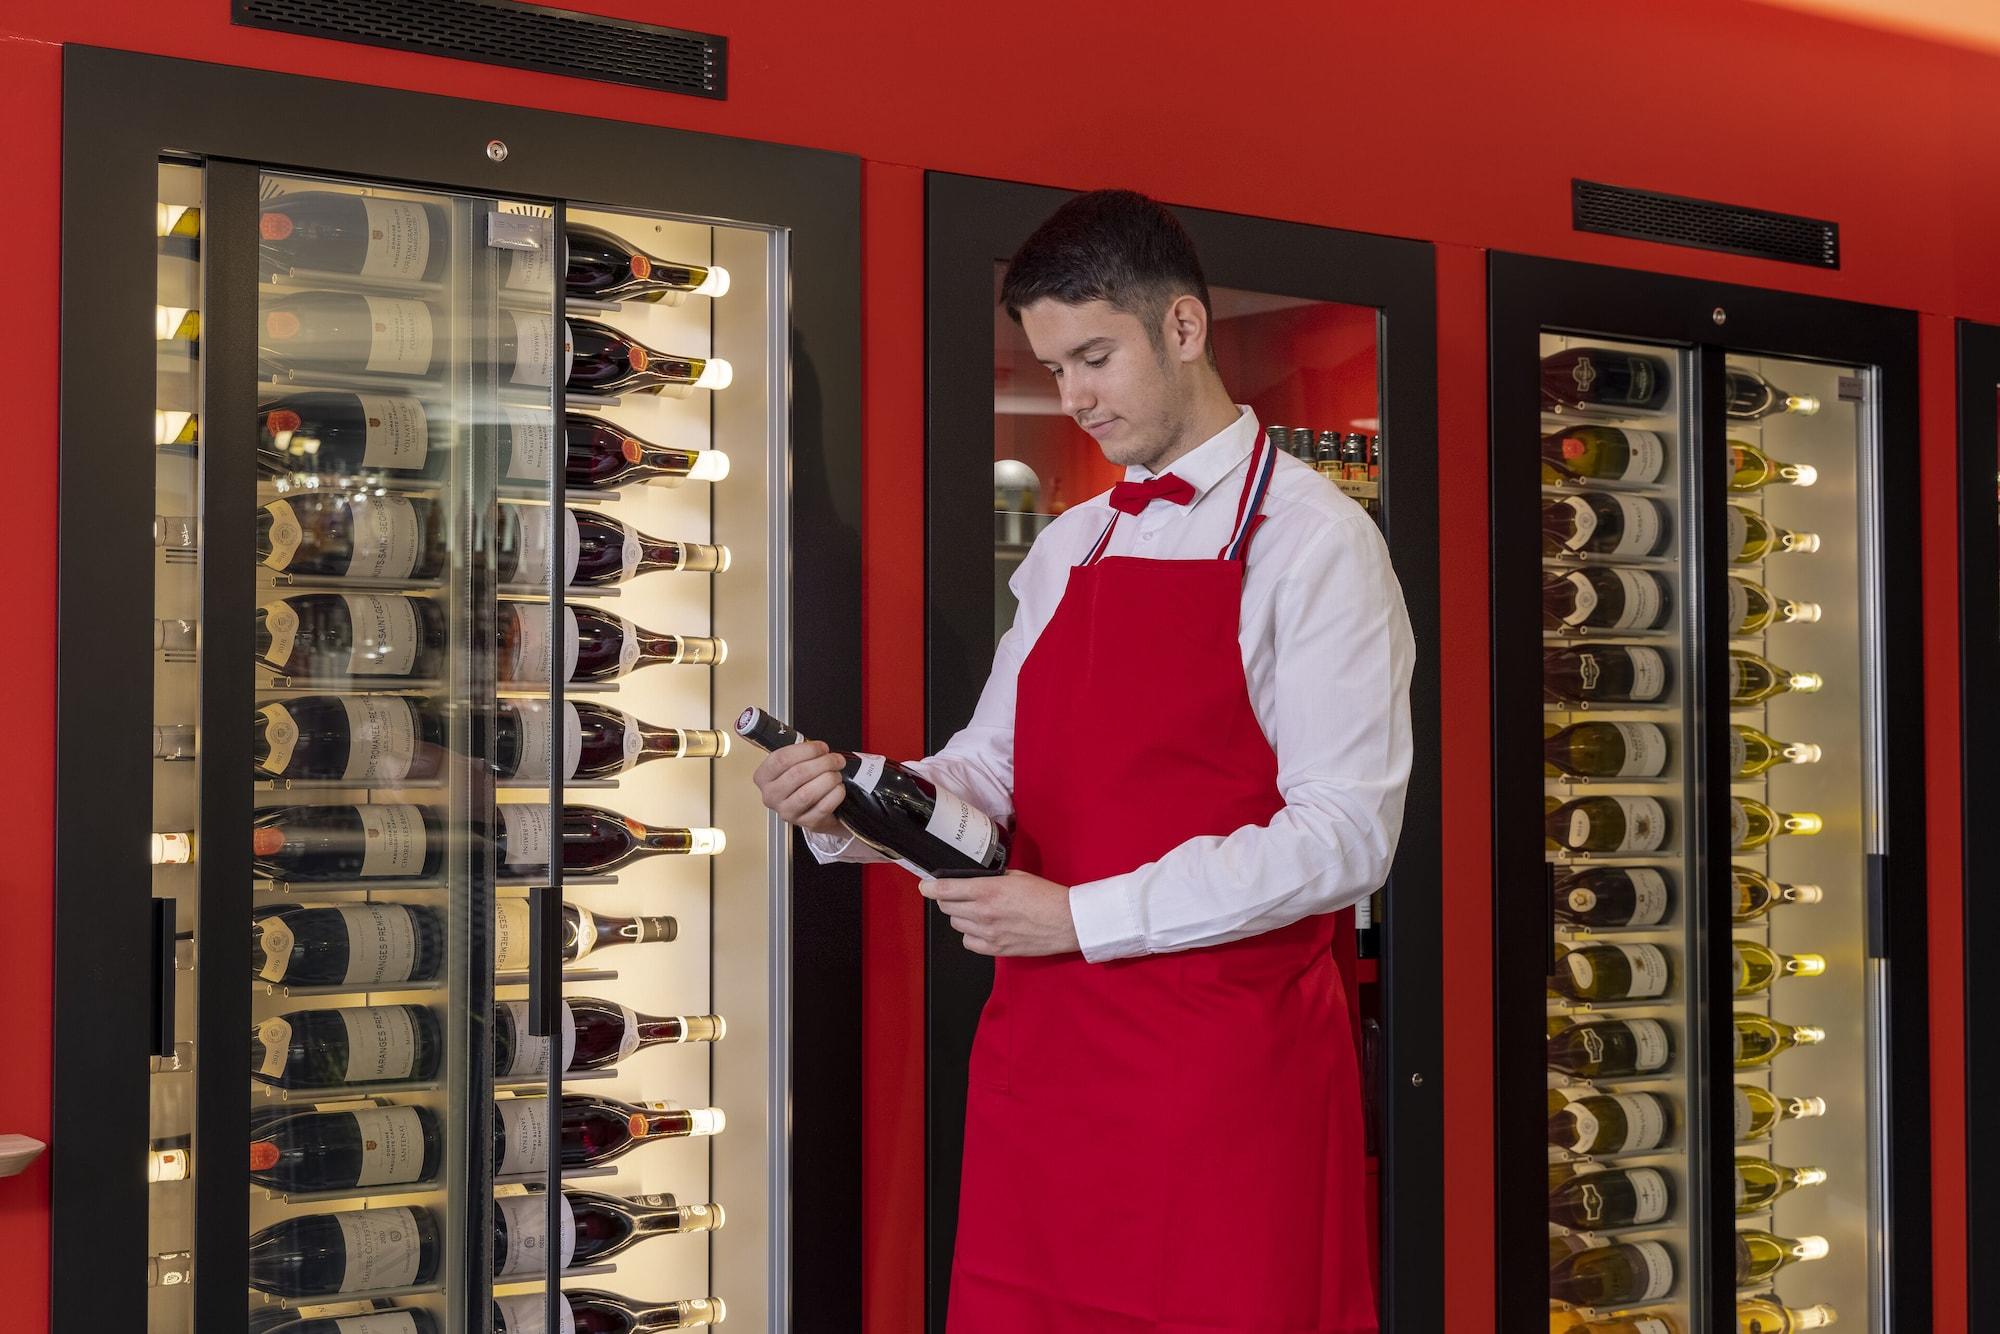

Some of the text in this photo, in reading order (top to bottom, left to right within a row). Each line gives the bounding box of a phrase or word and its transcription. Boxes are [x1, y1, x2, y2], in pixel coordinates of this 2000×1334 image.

[498, 931, 509, 963] PREMIER
[376, 1031, 388, 1075] MARANGES
[399, 1126, 408, 1161] SANTENAY
[521, 1118, 529, 1154] SANTENAY
[360, 1256, 372, 1285] HAUTES
